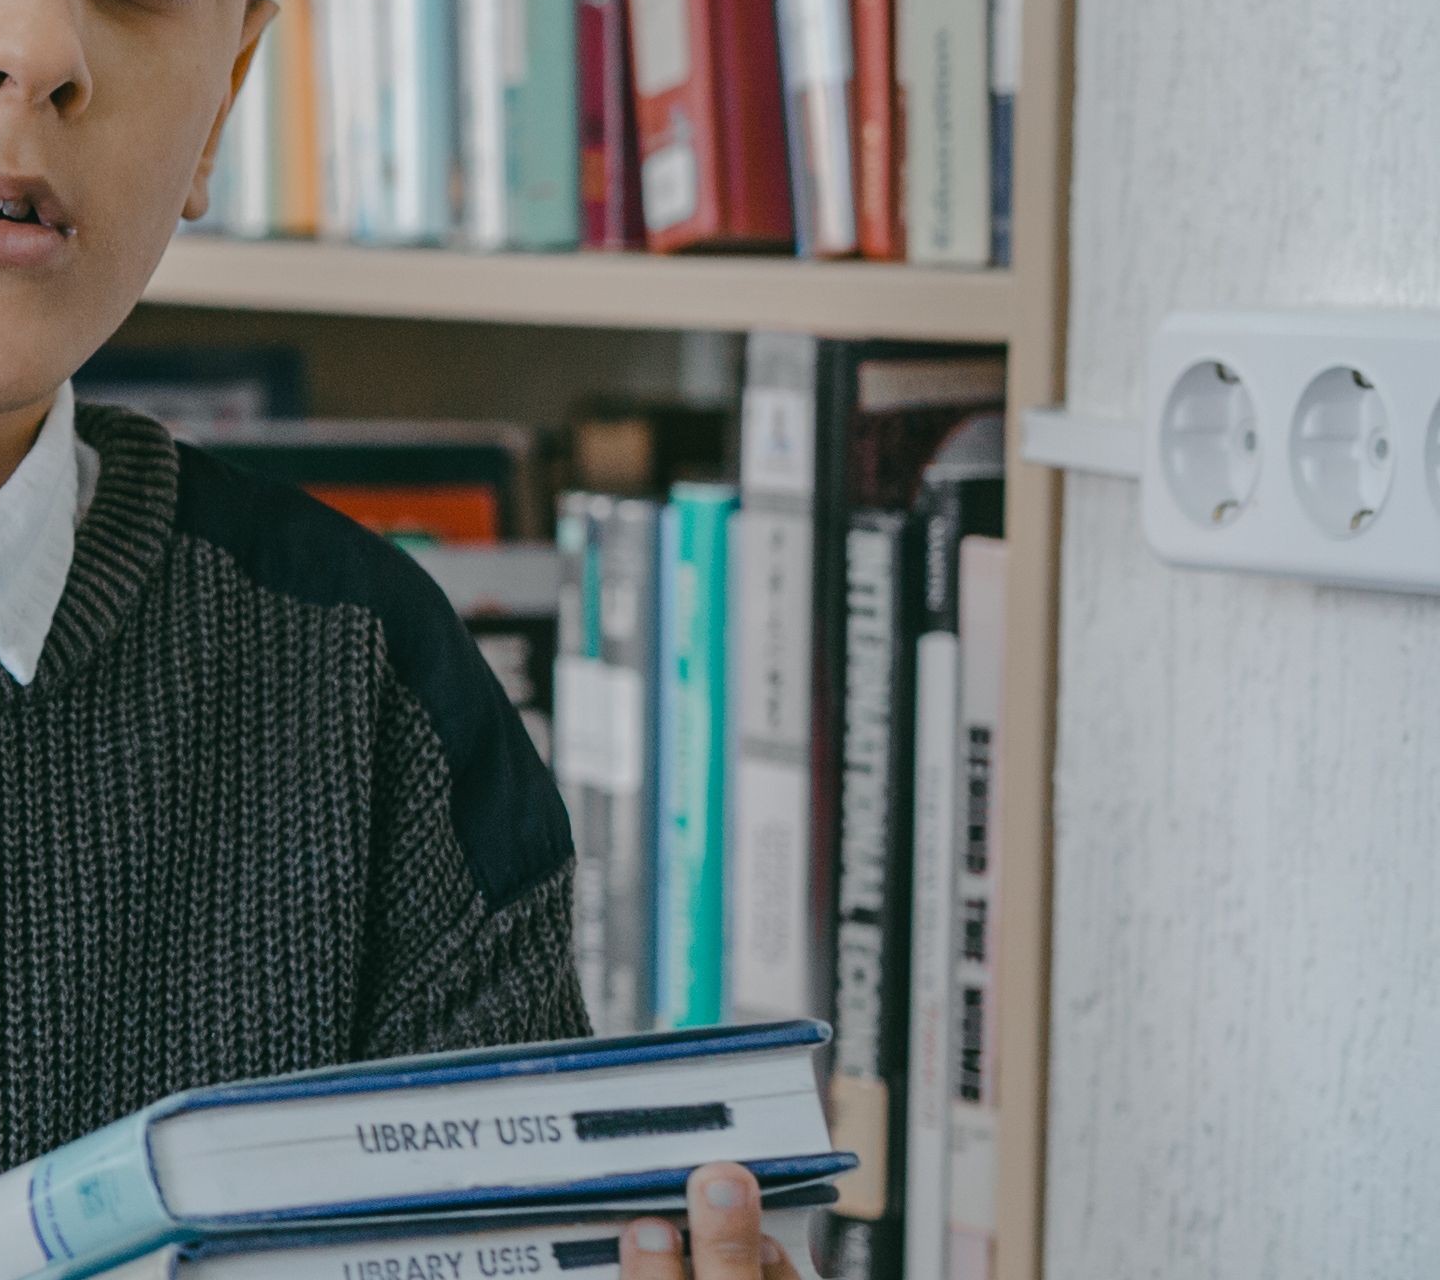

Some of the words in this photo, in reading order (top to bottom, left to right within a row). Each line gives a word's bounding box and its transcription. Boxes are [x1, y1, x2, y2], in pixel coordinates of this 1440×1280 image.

[356, 1120, 482, 1153] LIBRARY
[496, 1115, 561, 1145] USIS
[477, 1246, 541, 1277] USIS
